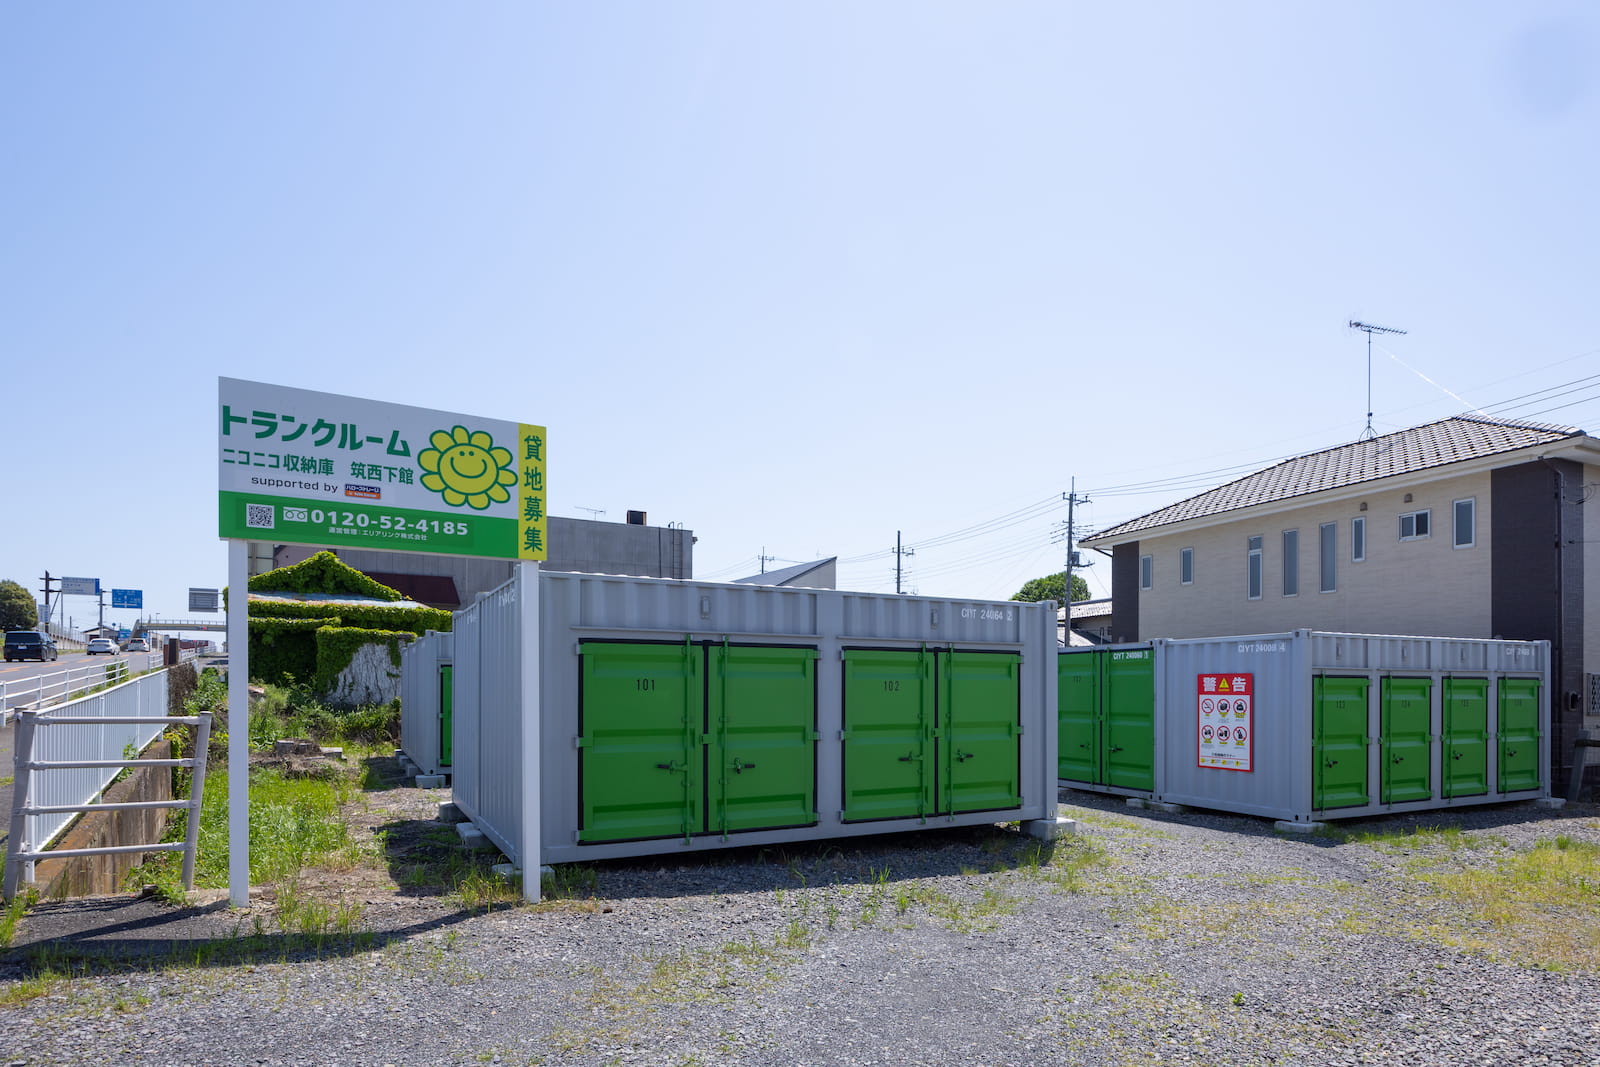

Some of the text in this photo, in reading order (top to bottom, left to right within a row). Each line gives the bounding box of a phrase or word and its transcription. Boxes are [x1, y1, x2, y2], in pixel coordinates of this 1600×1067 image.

[222, 405, 412, 457] トランクルーム
[223, 448, 414, 485] ニコニコ収納庫 筑西下館
[251, 476, 338, 494] supported by
[523, 435, 543, 552] 貸地募集
[310, 509, 469, 536] 0120-52-4185
[635, 679, 655, 691] 101
[883, 680, 899, 692] 102
